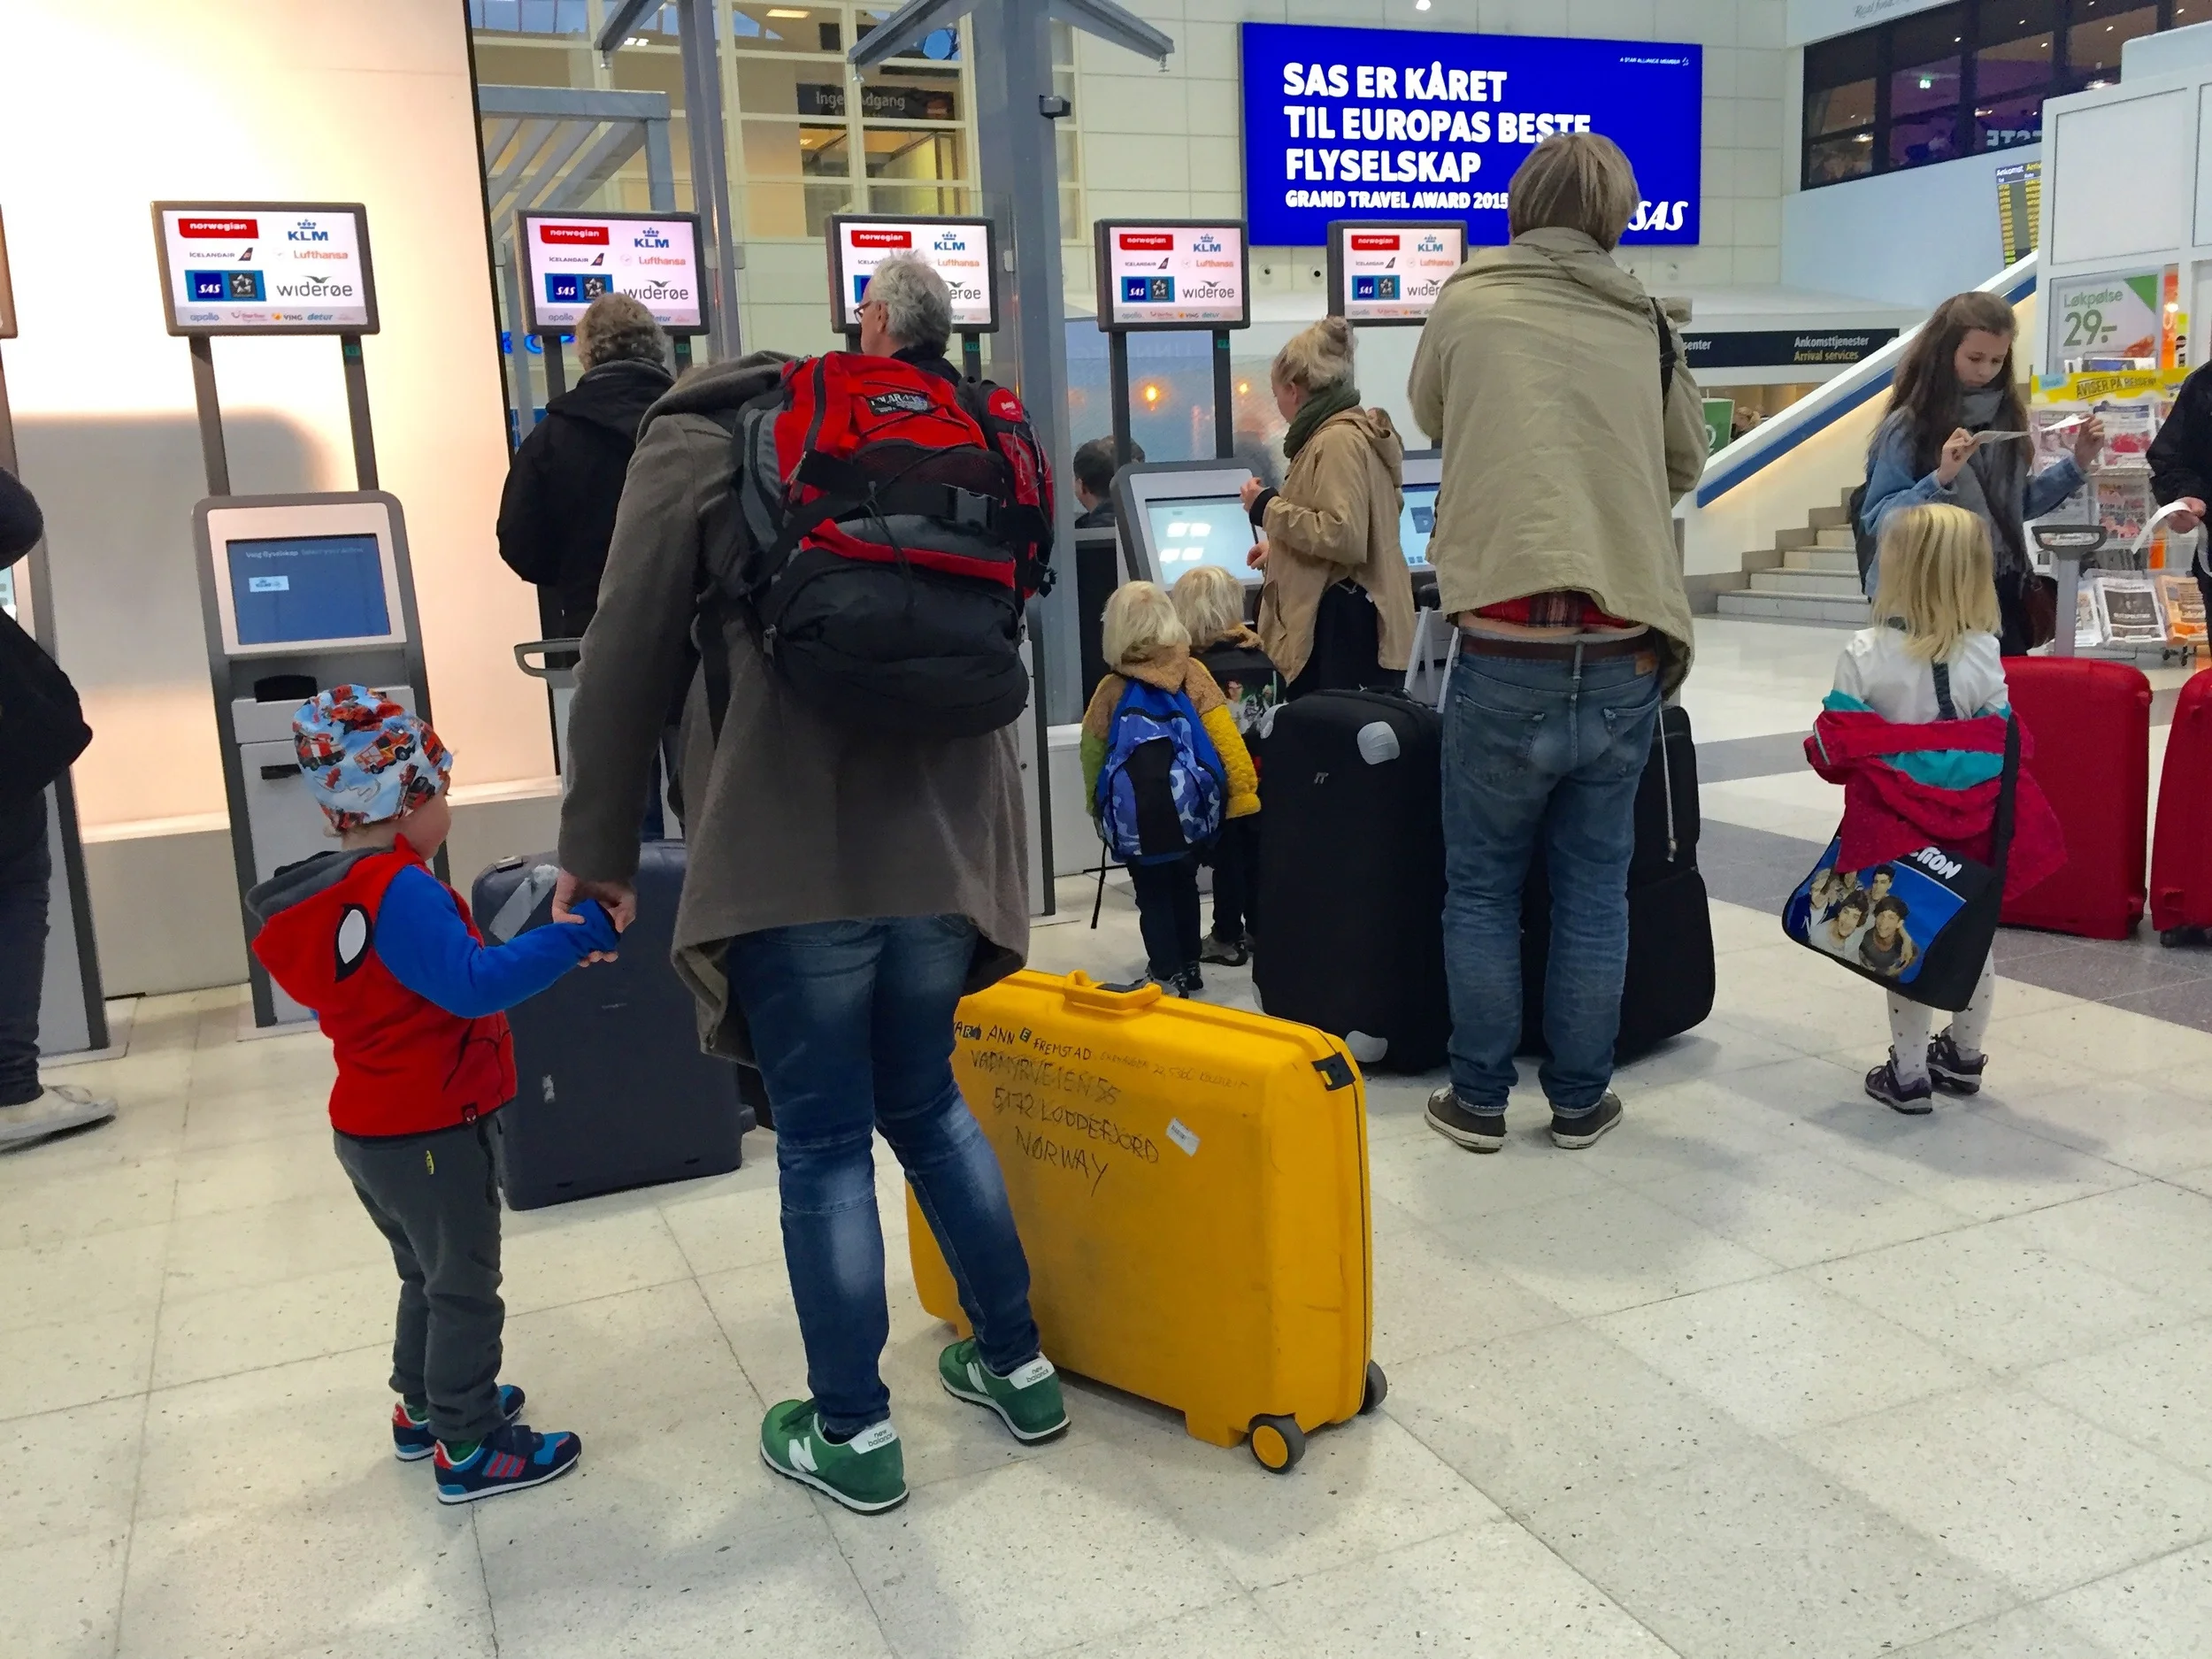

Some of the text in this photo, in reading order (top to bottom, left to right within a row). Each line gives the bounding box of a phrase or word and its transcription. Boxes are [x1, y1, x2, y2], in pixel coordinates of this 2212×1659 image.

[1284, 61, 1507, 102] SAS ER KÅRET
[816, 91, 845, 108] Inge
[1284, 106, 1591, 143] TIL EUROPAS BESTE
[1286, 149, 1480, 182] FLYSELSKAP
[1286, 190, 1509, 209] GRAND TRAVEL AWARD 2015
[1628, 201, 1688, 231] SAS
[189, 222, 247, 231] norwegian
[288, 231, 328, 241] KLM
[550, 229, 600, 238] norwegian
[634, 238, 669, 248] KLM
[294, 250, 349, 259] Lufthansa
[639, 257, 686, 265] Lufthansa
[938, 258, 980, 267] Lufthansa
[198, 284, 221, 293] SAS
[277, 281, 352, 296] widerøe
[556, 287, 575, 296] SAS
[624, 286, 688, 300] widerøe
[950, 288, 980, 299] erøe
[1183, 286, 1234, 298] widerøe
[1407, 283, 1440, 296] wider
[2063, 288, 2124, 309] Løkpølse
[1794, 336, 1869, 349] Ankomsttjenester
[1793, 350, 1858, 362] Arrival services
[986, 1025, 1015, 1045] ANN
[1033, 1037, 1092, 1061] FREMSTAD
[1041, 1099, 1159, 1164] LODDEFJORD
[1016, 1125, 1109, 1197] NORWAY
